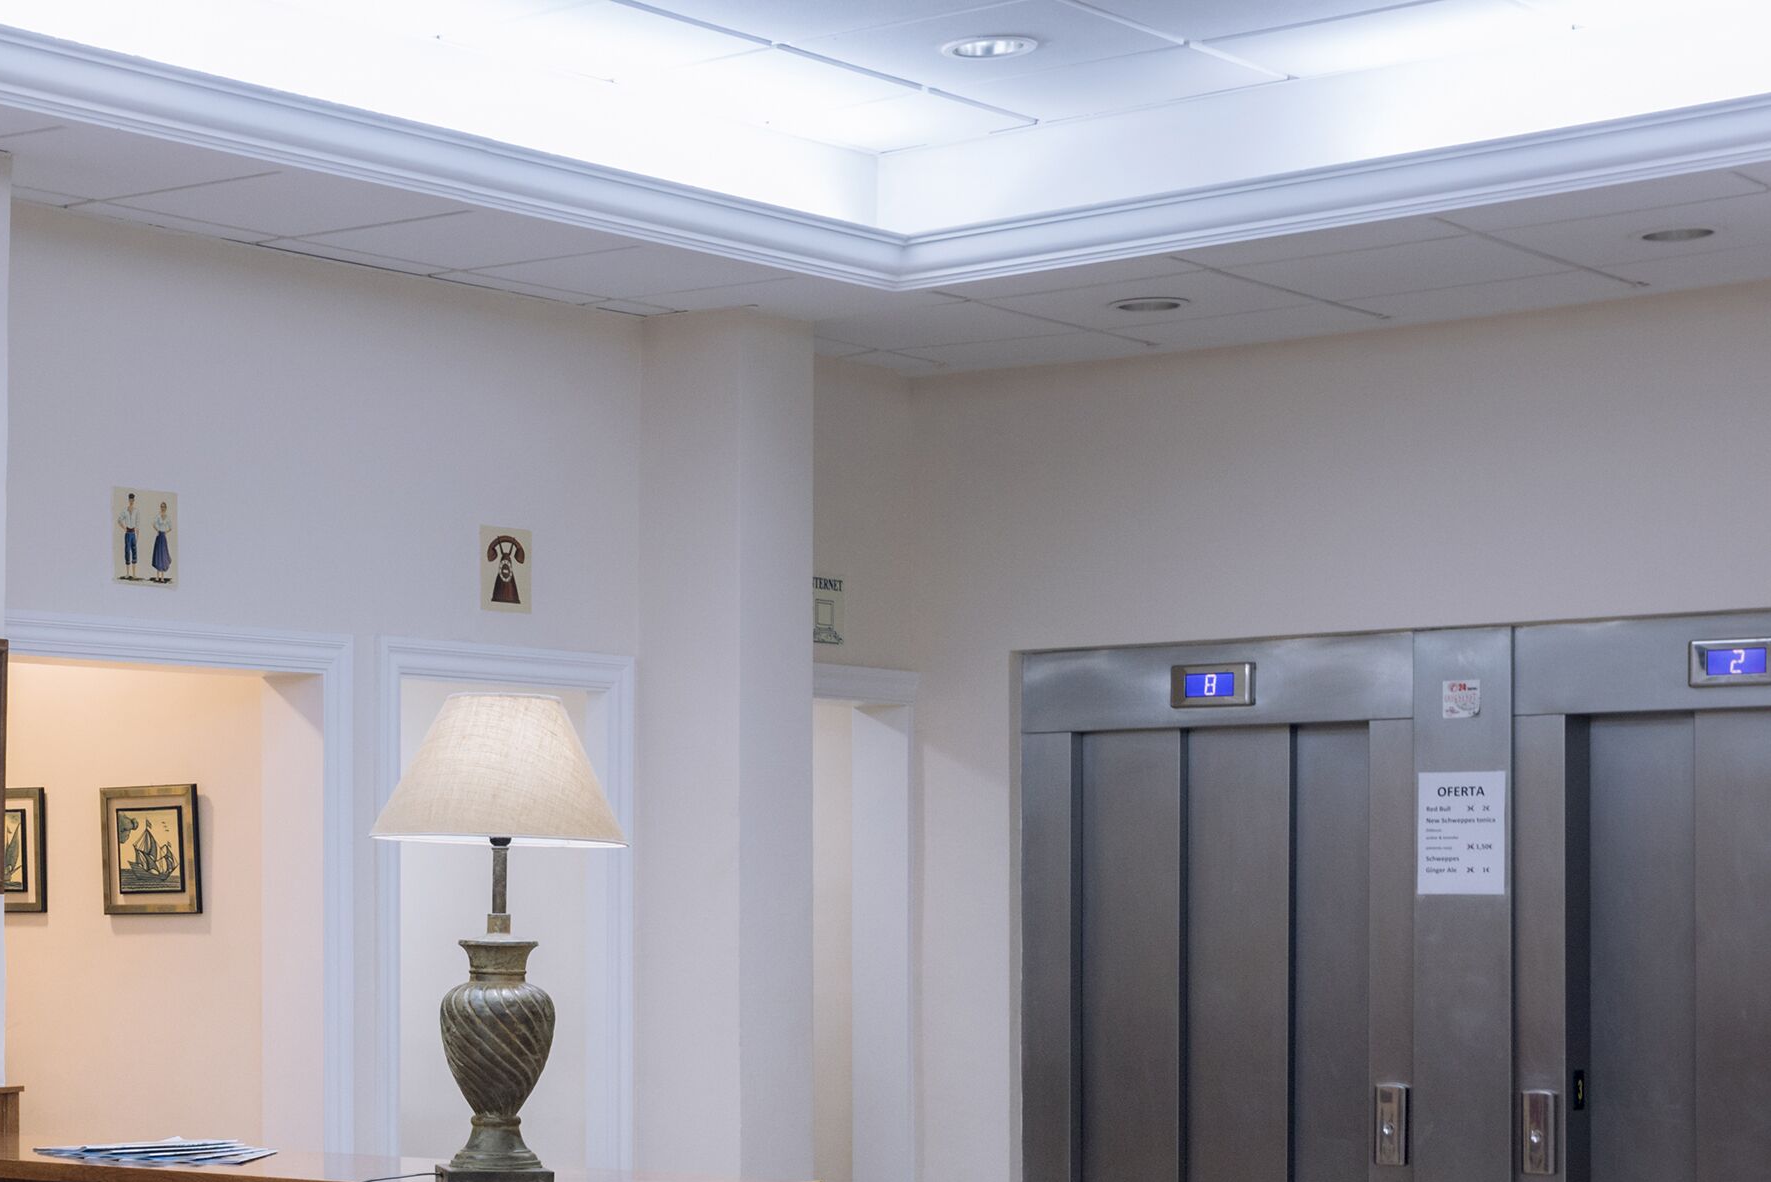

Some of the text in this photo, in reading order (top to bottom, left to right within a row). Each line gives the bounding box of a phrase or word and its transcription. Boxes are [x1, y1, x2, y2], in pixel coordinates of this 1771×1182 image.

[1730, 649, 1745, 674] 2
[1204, 674, 1217, 696] 8
[1459, 683, 1466, 692] 24
[1437, 786, 1485, 797] OFERTA
[1578, 1079, 1583, 1101] 3
